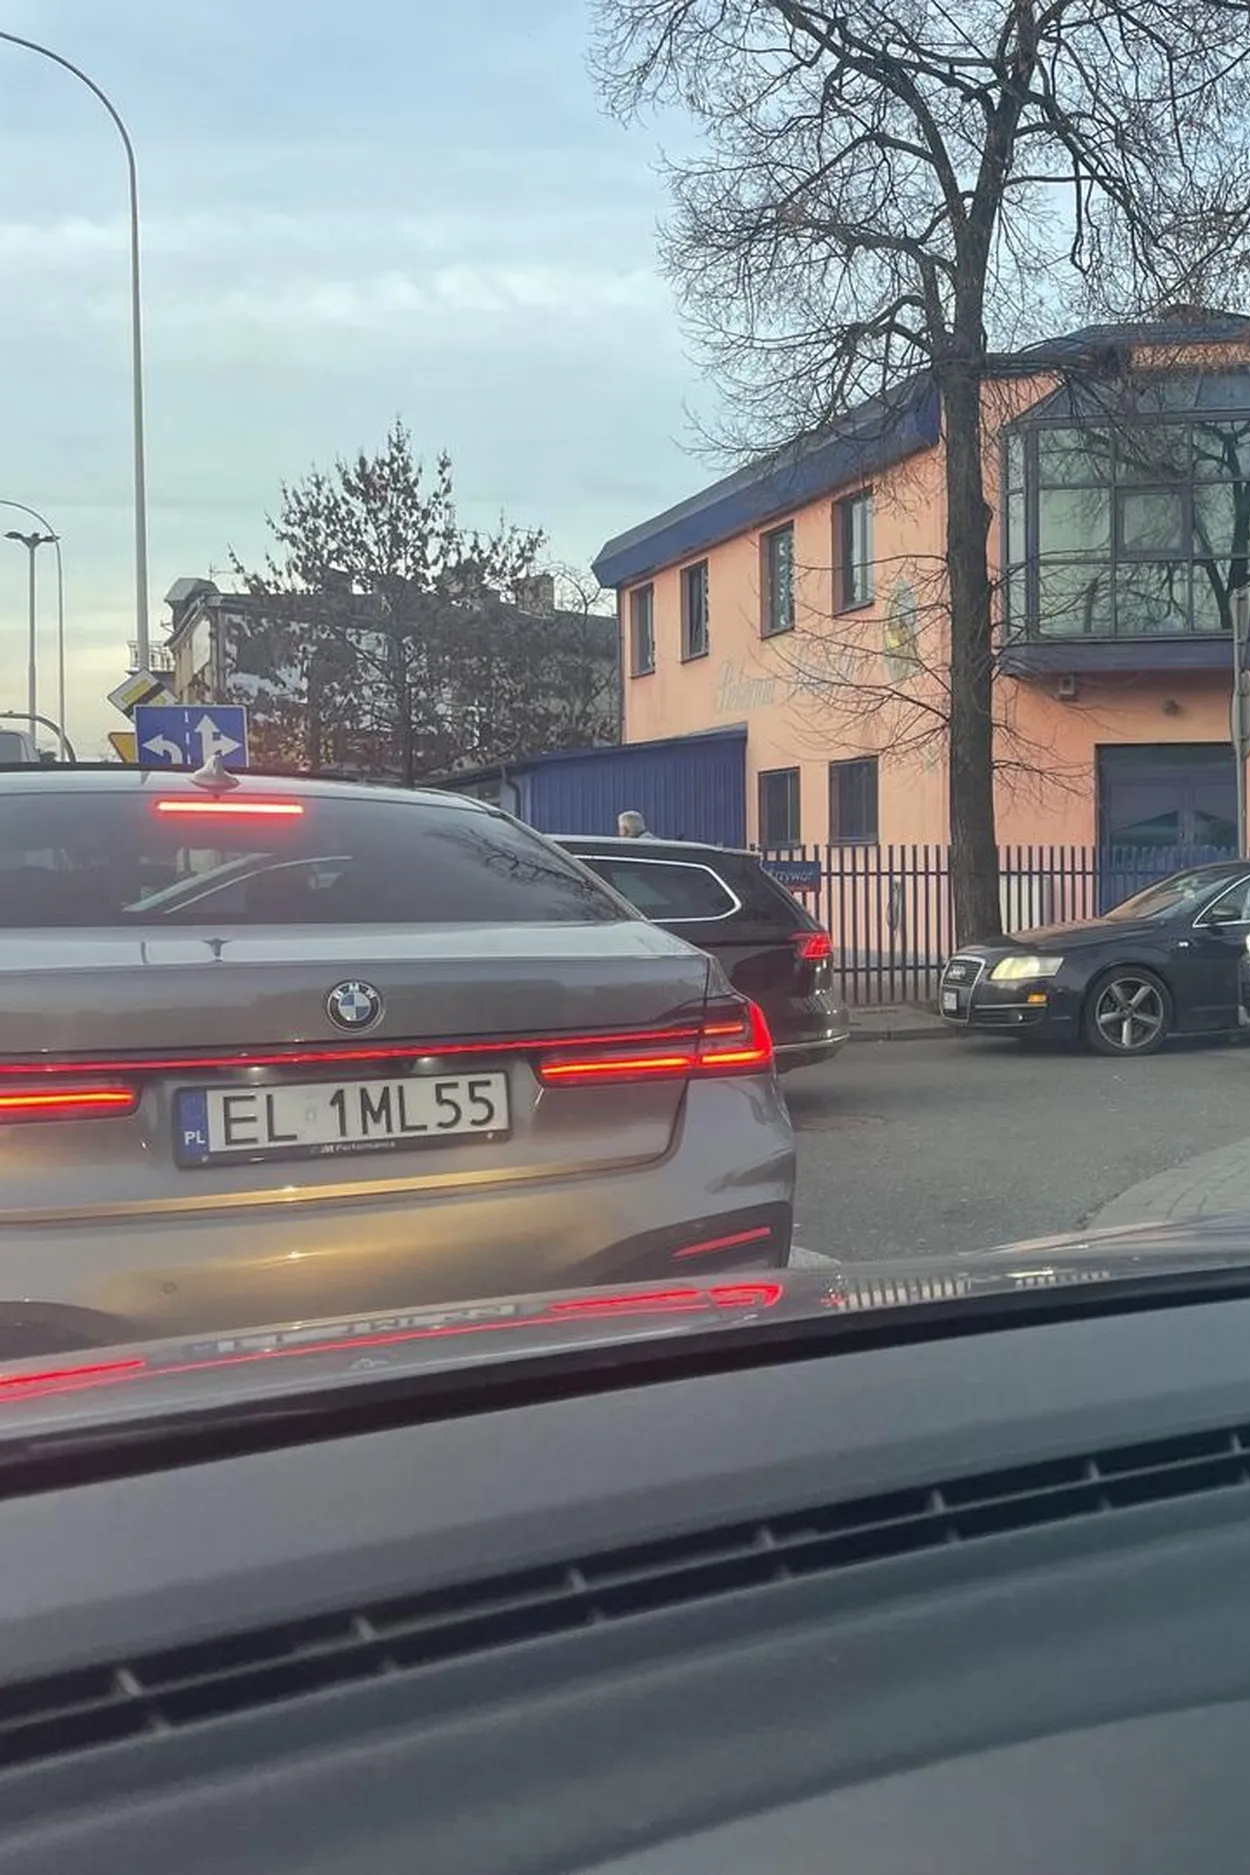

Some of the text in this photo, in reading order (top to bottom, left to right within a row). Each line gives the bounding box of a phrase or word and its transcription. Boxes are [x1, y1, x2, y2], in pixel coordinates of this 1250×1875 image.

[222, 1080, 496, 1146] EL 1ML55
[184, 1131, 206, 1145] PL
